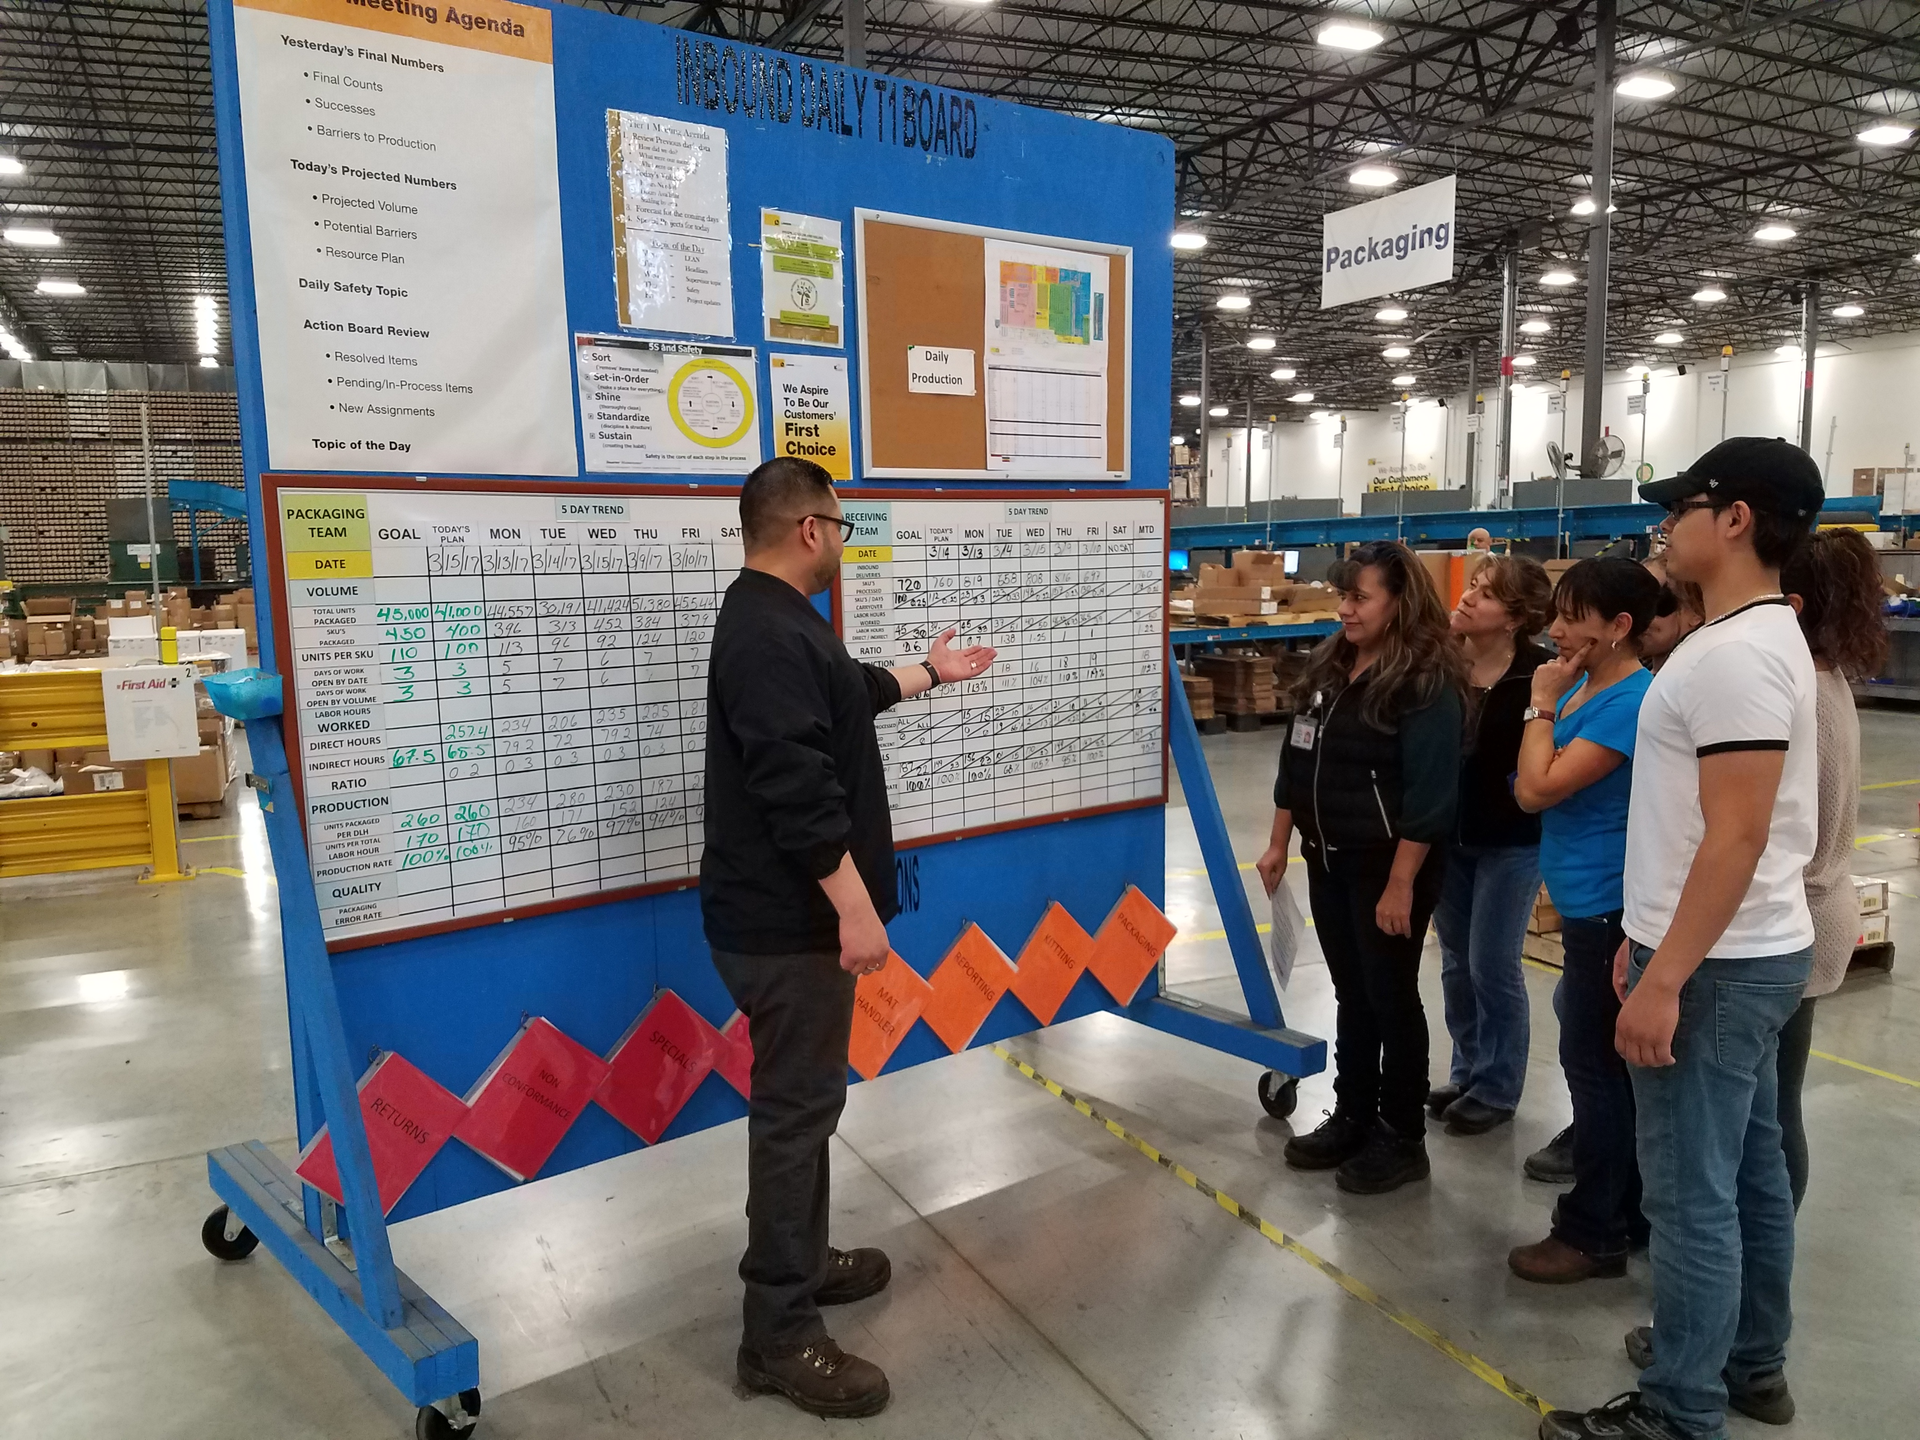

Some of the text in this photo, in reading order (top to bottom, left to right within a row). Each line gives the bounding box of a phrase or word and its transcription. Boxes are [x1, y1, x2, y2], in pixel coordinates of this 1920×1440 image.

[445, 7, 525, 37] Agenda
[281, 35, 444, 74] Yesterday's Final Numbers
[313, 71, 383, 92] Final Counts
[676, 36, 792, 124] INBOUND
[799, 61, 868, 139] DAILY
[904, 83, 977, 160] BOARD
[315, 97, 376, 116] Successes
[317, 125, 436, 152] Barriers to Production
[290, 159, 457, 191] Today's Projected Numbers
[322, 193, 418, 216] Projected Volume
[323, 220, 417, 241] Potential Barriers
[1326, 221, 1450, 273] Packaging
[326, 246, 405, 265] Resource Plan
[299, 277, 408, 299] Daily Safety Topic
[303, 319, 430, 340] Action Board Review
[649, 343, 702, 356] 5S and Safety
[335, 352, 418, 368] Resolved Items
[592, 353, 611, 362] Sort
[925, 350, 949, 365] Daily
[337, 377, 473, 395] Pending/In-Process Items
[594, 374, 650, 385] Set-in-Order
[912, 372, 963, 387] Production
[595, 392, 621, 402] Shine
[783, 383, 829, 398] We Aspire
[783, 397, 829, 410] To Be Our
[339, 403, 435, 418] New Assignments
[784, 409, 837, 421] Customers'
[597, 412, 650, 423] Standardize
[599, 431, 632, 442] Sustain
[785, 422, 821, 438] First
[312, 439, 411, 454] Topic of the Day
[786, 441, 837, 457] Choice
[1373, 476, 1387, 485] Our
[287, 508, 365, 521] PACKAGING
[561, 505, 624, 516] 5 DAY TREND
[845, 512, 887, 523] RECEIVING
[308, 527, 347, 539] TEAM
[378, 528, 421, 541] GOAL
[432, 525, 471, 535] TODAY'S
[489, 528, 521, 540] MON
[540, 528, 565, 539] TUE
[587, 528, 617, 539] WED
[633, 528, 658, 539] THU
[682, 528, 700, 539] FRI
[721, 527, 743, 538] SAT
[855, 527, 879, 537] TEAM
[896, 530, 923, 541] GOAL
[964, 529, 984, 539] MON
[996, 528, 1013, 539] TUE
[1026, 528, 1045, 538] WED
[1056, 527, 1072, 537] THU
[1087, 527, 1099, 537] FRI
[1113, 526, 1127, 535] SAT
[1139, 525, 1155, 535] MTD
[440, 535, 465, 545] PLAN
[858, 549, 877, 559] DATE
[315, 559, 347, 569] DATE
[306, 586, 359, 598] VOLUME
[313, 607, 357, 616] TOTAL UNITS
[314, 617, 357, 626] PACKAGED
[319, 639, 355, 647] PACKAGED
[302, 650, 374, 663] UNITS PER SKU
[860, 646, 882, 656] RATIO
[185, 668, 191, 678] 2
[121, 678, 167, 691] First Aid
[311, 677, 368, 688] OPEN BY DATE
[306, 696, 377, 708] OPEN BY VOLUME
[315, 707, 371, 719] LABOR HOURS
[318, 719, 370, 733] WORKED
[310, 736, 381, 751] DIRECT HOURS
[309, 755, 386, 772] INDIRECT HOURS
[331, 778, 367, 791] RATIO
[312, 795, 390, 815] PRODUCTION
[324, 818, 381, 831] UNITS PACKAGED
[337, 828, 369, 839] PER DLH
[325, 837, 381, 851] UNITS PER TOTAL
[328, 847, 380, 861] LABOR HOUR
[316, 858, 393, 878] PRODUCTION RATE
[332, 881, 382, 899] QUALITY
[338, 902, 377, 914] PACKAGING
[335, 911, 383, 926] ERROR RATE
[1117, 912, 1158, 958] PACKAGING
[1044, 933, 1076, 970] KITTING
[955, 951, 996, 1001] REPORTING
[876, 986, 899, 1010] MAT
[856, 996, 896, 1037] HANDLER
[649, 1030, 697, 1073] SPECIALS
[537, 1069, 561, 1089] NON
[502, 1072, 570, 1119] CONFORMANCE
[370, 1097, 429, 1146] RETURNS
